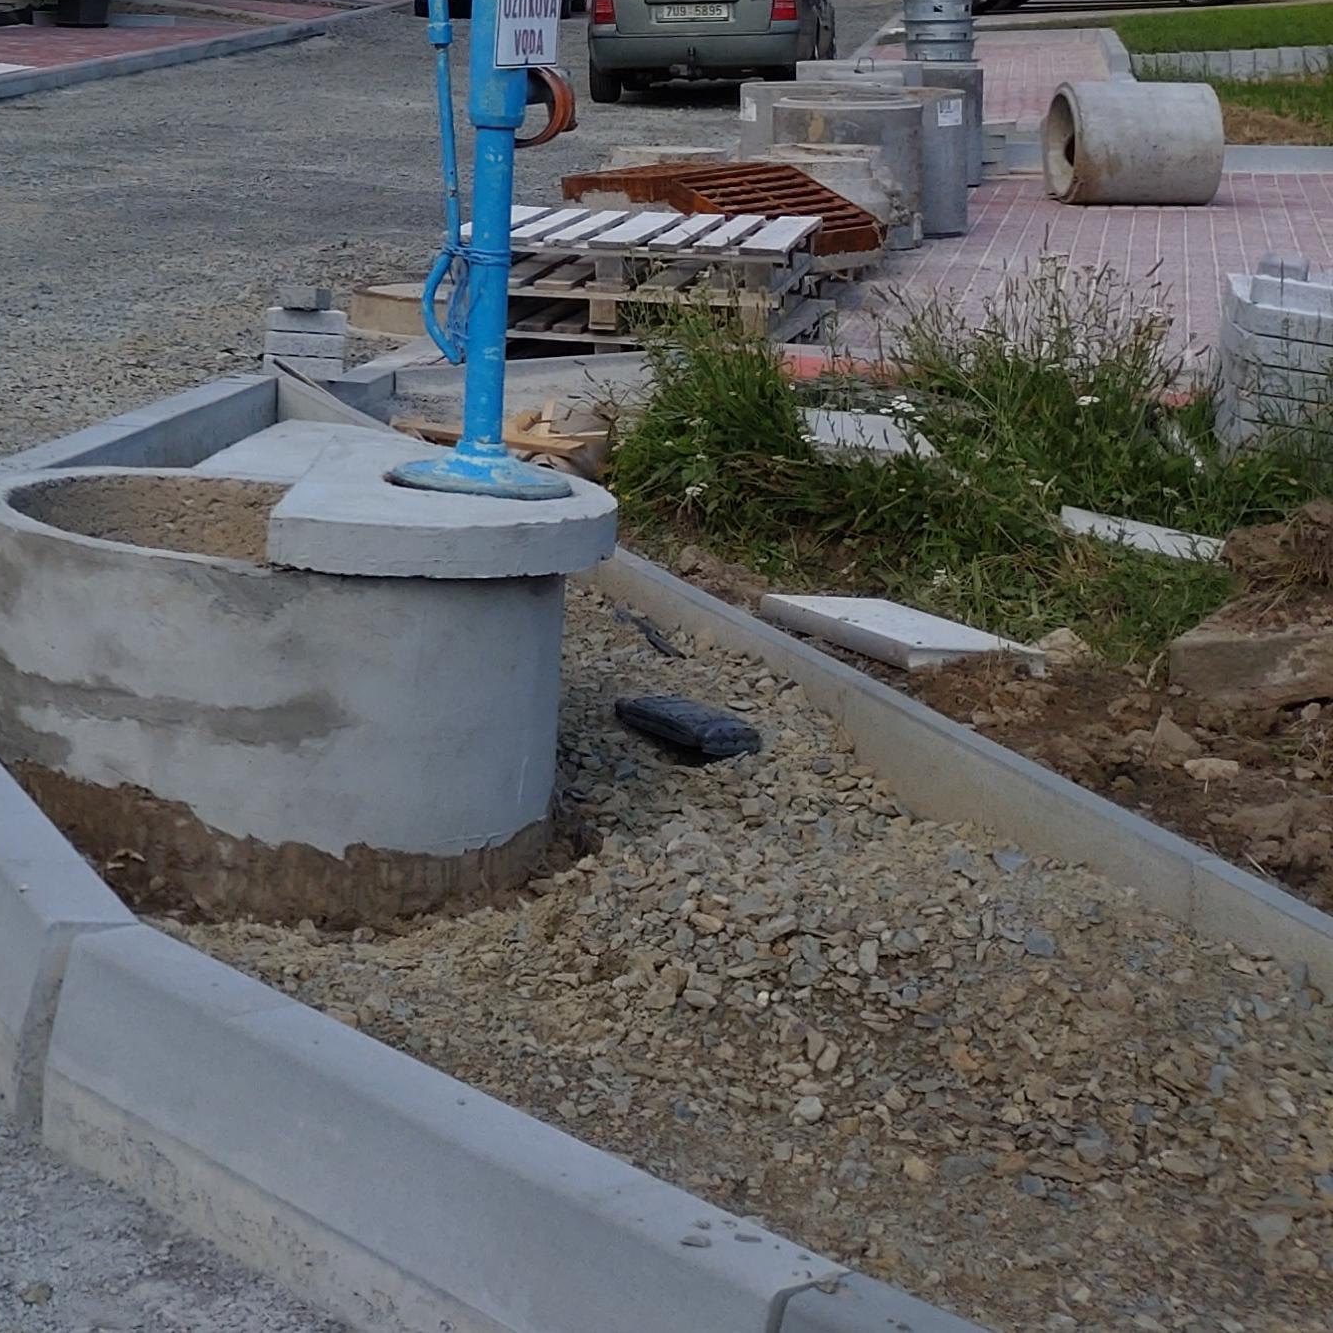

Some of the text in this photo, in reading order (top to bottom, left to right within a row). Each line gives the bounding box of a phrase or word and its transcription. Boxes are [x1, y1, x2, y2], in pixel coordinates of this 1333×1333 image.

[666, 4, 723, 17] 7U9 5895
[514, 28, 544, 56] VODA
